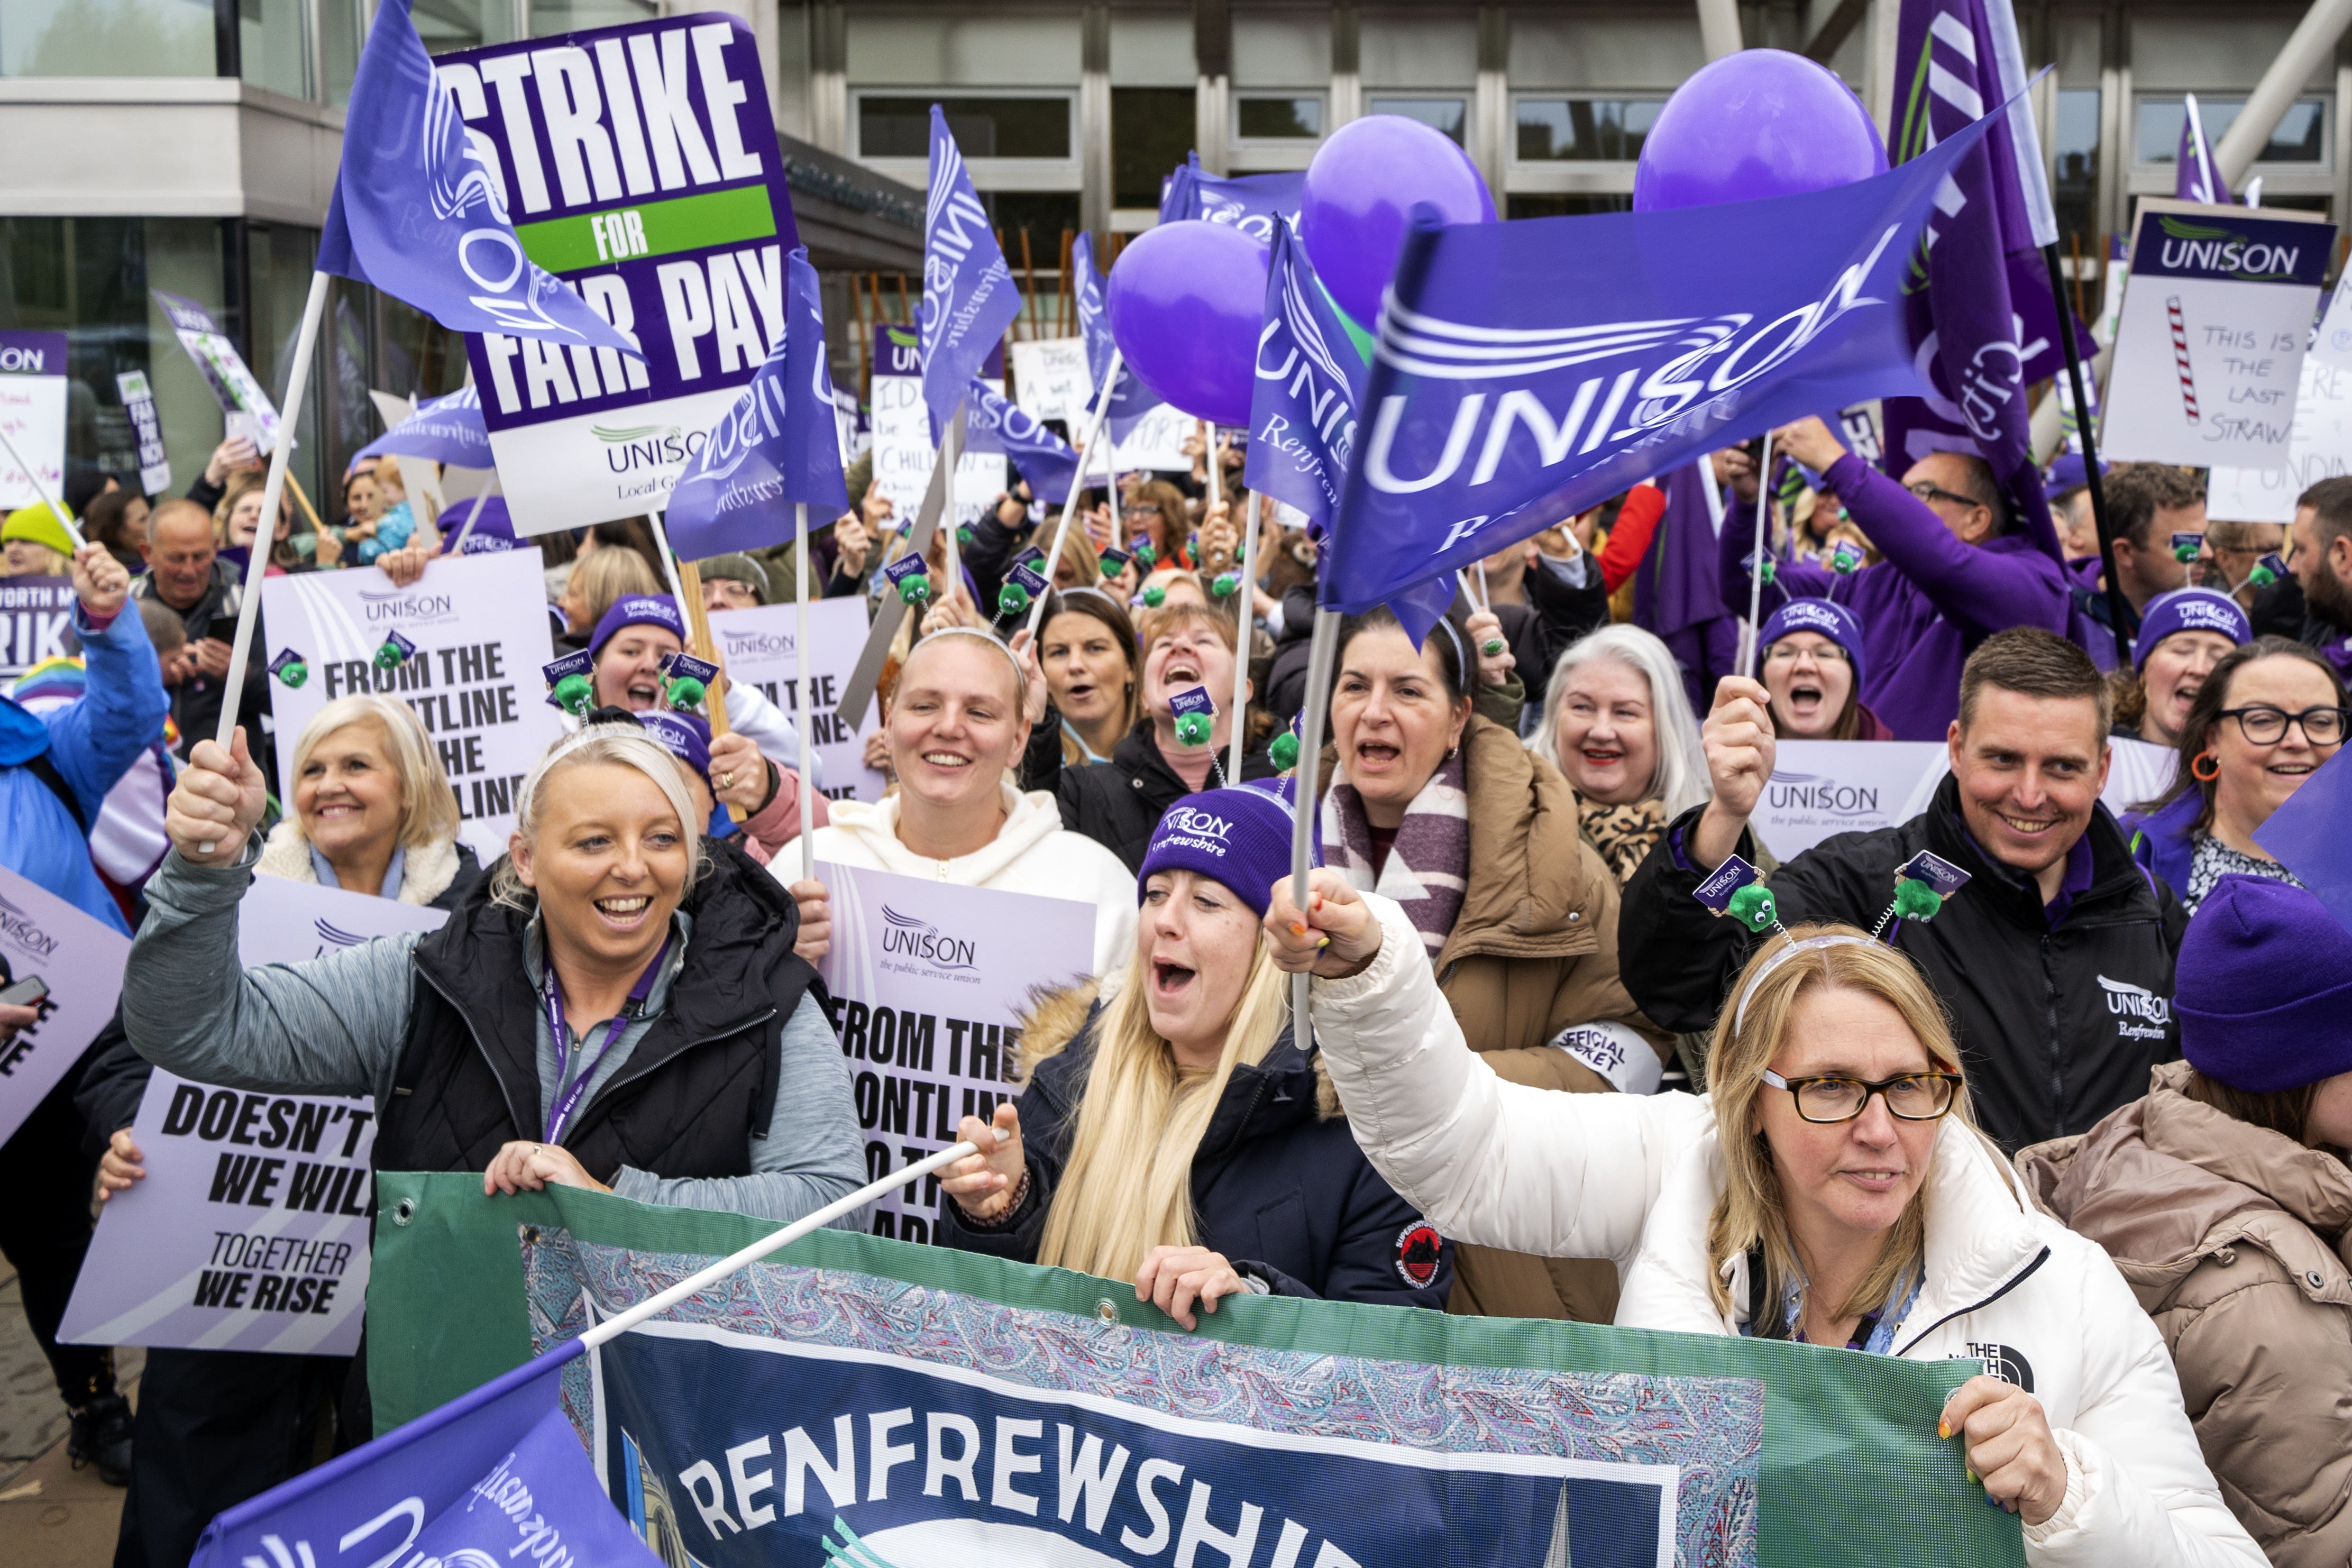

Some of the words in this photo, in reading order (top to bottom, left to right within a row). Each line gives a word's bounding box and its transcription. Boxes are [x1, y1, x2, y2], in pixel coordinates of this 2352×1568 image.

[437, 22, 763, 213] STRIKE
[591, 210, 648, 261] FOR
[2161, 238, 2300, 276] UNISON
[482, 274, 651, 414] FAIR
[656, 244, 788, 381] PAY
[2203, 325, 2257, 350] THIS
[2271, 333, 2295, 352] IS
[1363, 221, 1903, 494] UNISON
[2223, 357, 2275, 377] THE
[1256, 318, 1358, 475] UNIS
[2228, 386, 2286, 407] LAST
[2202, 411, 2294, 445] STRAW
[607, 431, 708, 473] UNISO
[1257, 412, 1340, 507] Renfrew
[618, 475, 656, 499] Local
[366, 594, 452, 621] UNISON
[437, 641, 505, 685] THE
[728, 634, 794, 657] UNISON
[550, 656, 584, 675] UNISON
[680, 661, 711, 677] UNISON
[418, 685, 519, 733] TLINE
[1176, 693, 1204, 710] UNISON
[438, 735, 486, 777] HE
[1770, 786, 1878, 810] UNISON
[1770, 815, 1786, 826] the
[1788, 815, 1817, 827] public
[1706, 865, 1740, 898] UNISON
[1920, 859, 1959, 885] UNISON
[0, 910, 59, 956] NISON
[883, 927, 975, 965] UNISON
[880, 958, 893, 970] the
[893, 962, 920, 975] public
[921, 969, 953, 980] service
[954, 974, 982, 985] union
[2107, 992, 2169, 1019] UNISON
[831, 996, 936, 1072] FROM
[1559, 1030, 1625, 1064] FFICIAL
[161, 1083, 373, 1159] DOESN'T
[855, 1071, 1022, 1144] ONTLIN
[209, 1153, 287, 1208] WE
[285, 1162, 372, 1218] WIL
[210, 1232, 352, 1276] TOGETHER
[193, 1269, 253, 1310] WE
[250, 1274, 340, 1315] RISE
[1966, 1342, 1998, 1359] THE
[679, 1407, 1360, 1568] RENFREWSHI
